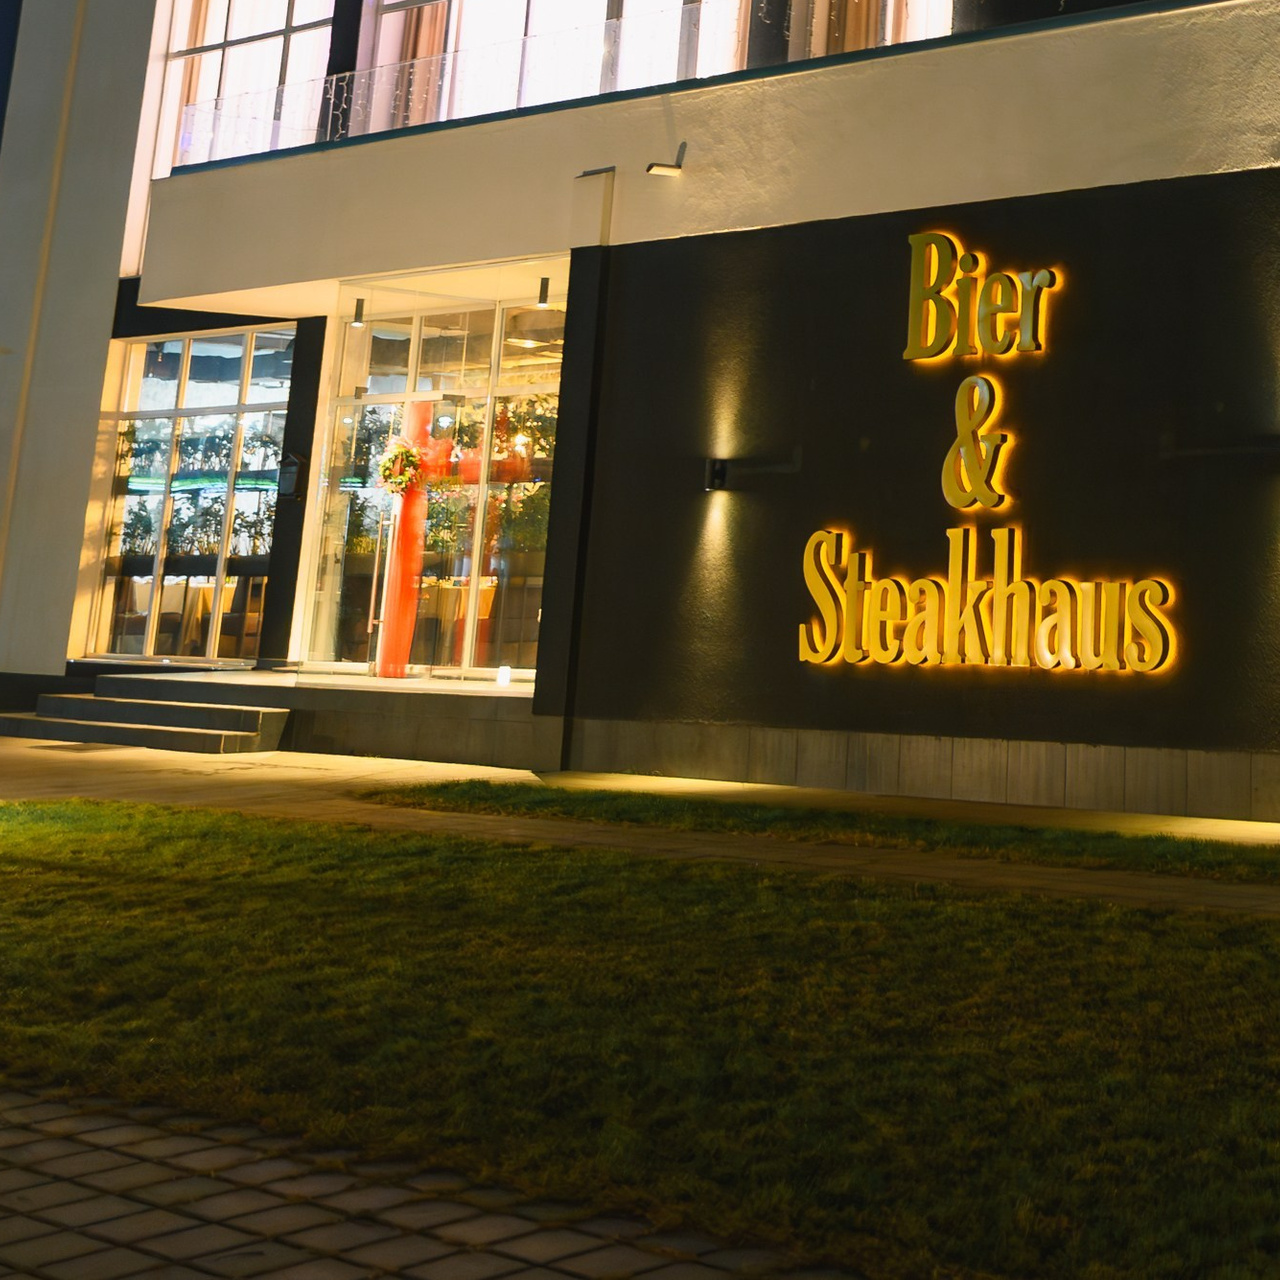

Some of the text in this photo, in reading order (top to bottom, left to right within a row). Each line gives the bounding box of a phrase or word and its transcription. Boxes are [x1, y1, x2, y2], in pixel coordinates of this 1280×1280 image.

[903, 231, 1058, 360] Bier
[941, 375, 1009, 509] &
[799, 527, 1172, 672] Steakhaus
